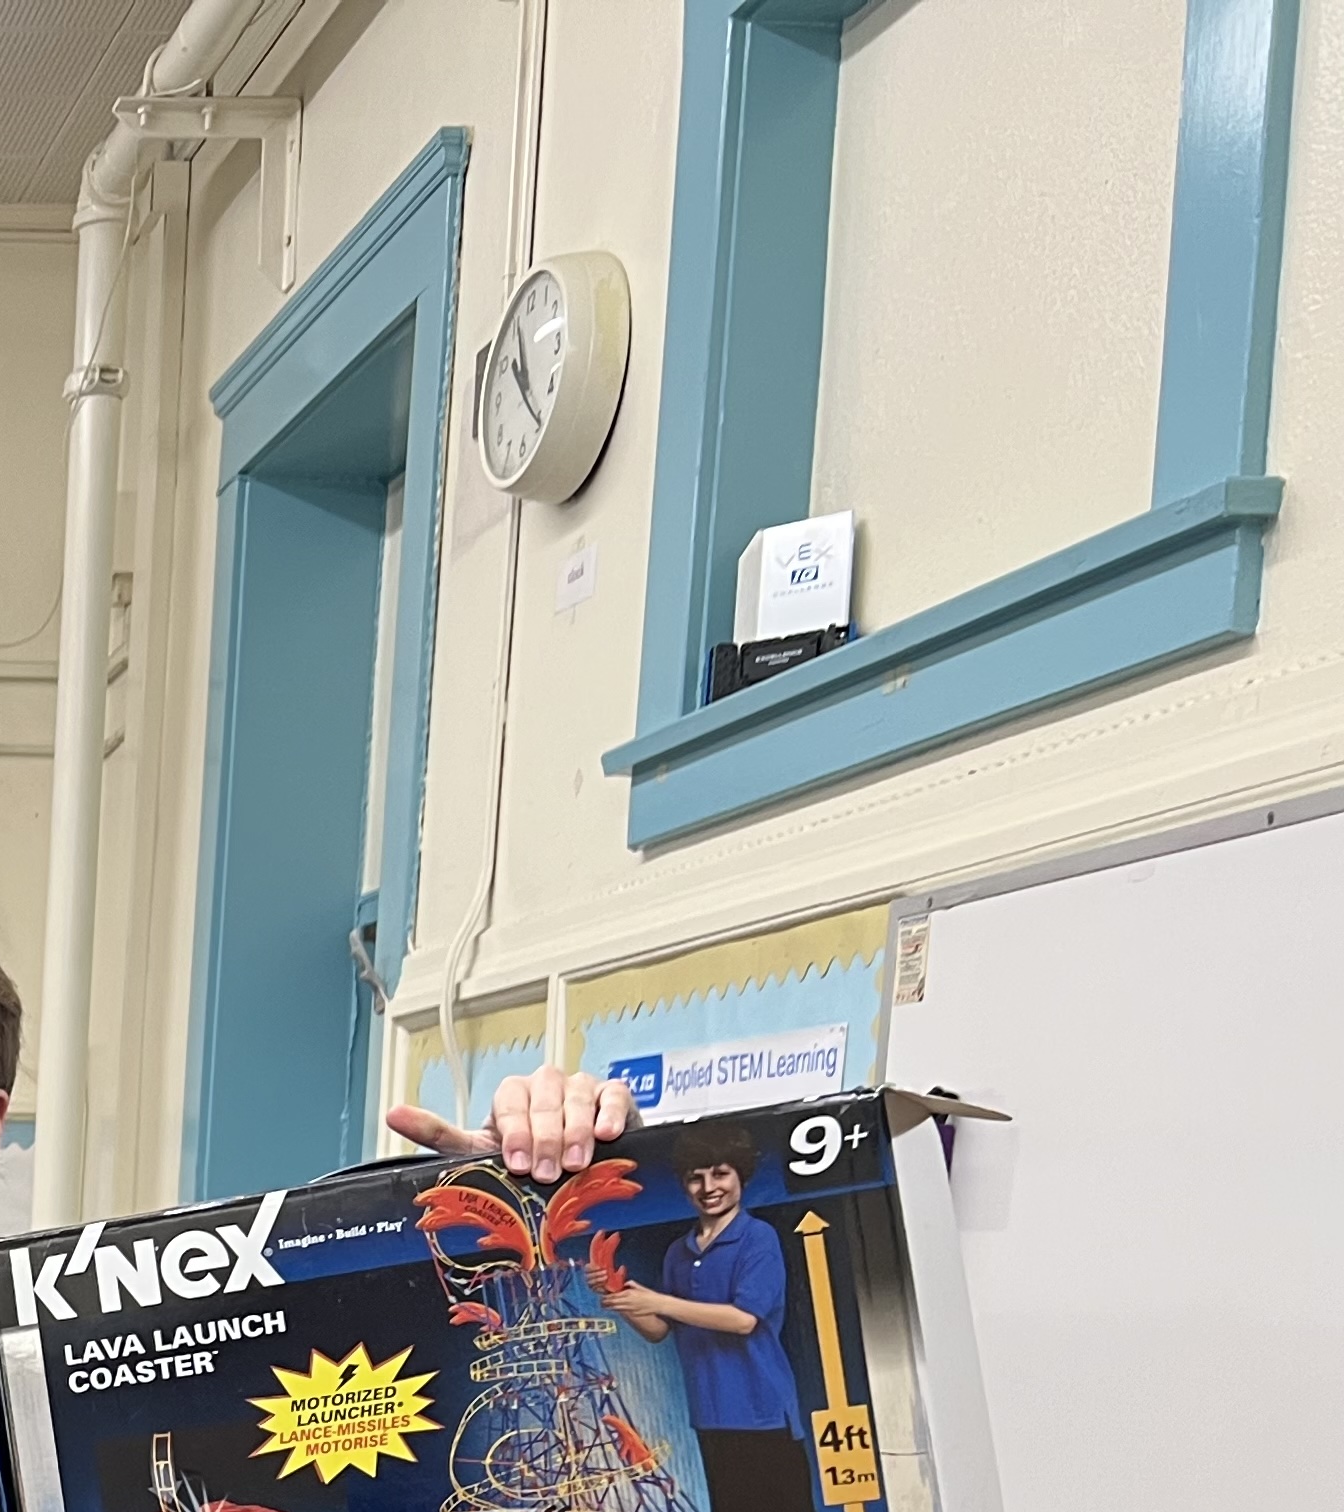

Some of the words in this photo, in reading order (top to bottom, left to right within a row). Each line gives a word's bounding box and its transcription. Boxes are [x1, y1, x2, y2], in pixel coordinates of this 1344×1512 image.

[553, 331, 561, 356] 3
[664, 1058, 714, 1098] Applied
[716, 1051, 763, 1085] STEM
[766, 1043, 839, 1078] Learning
[789, 1114, 869, 1176] 9+
[278, 1232, 325, 1251] Imagine
[336, 1224, 367, 1240] Build
[376, 1219, 403, 1234] Play
[63, 1333, 147, 1368] LAVA
[153, 1310, 288, 1353] LAUNCH
[67, 1351, 216, 1395] COASTER
[290, 1385, 398, 1413] MOTORIZED
[279, 1414, 411, 1445] LANCE-MISSILES
[818, 1420, 870, 1453] 4ft
